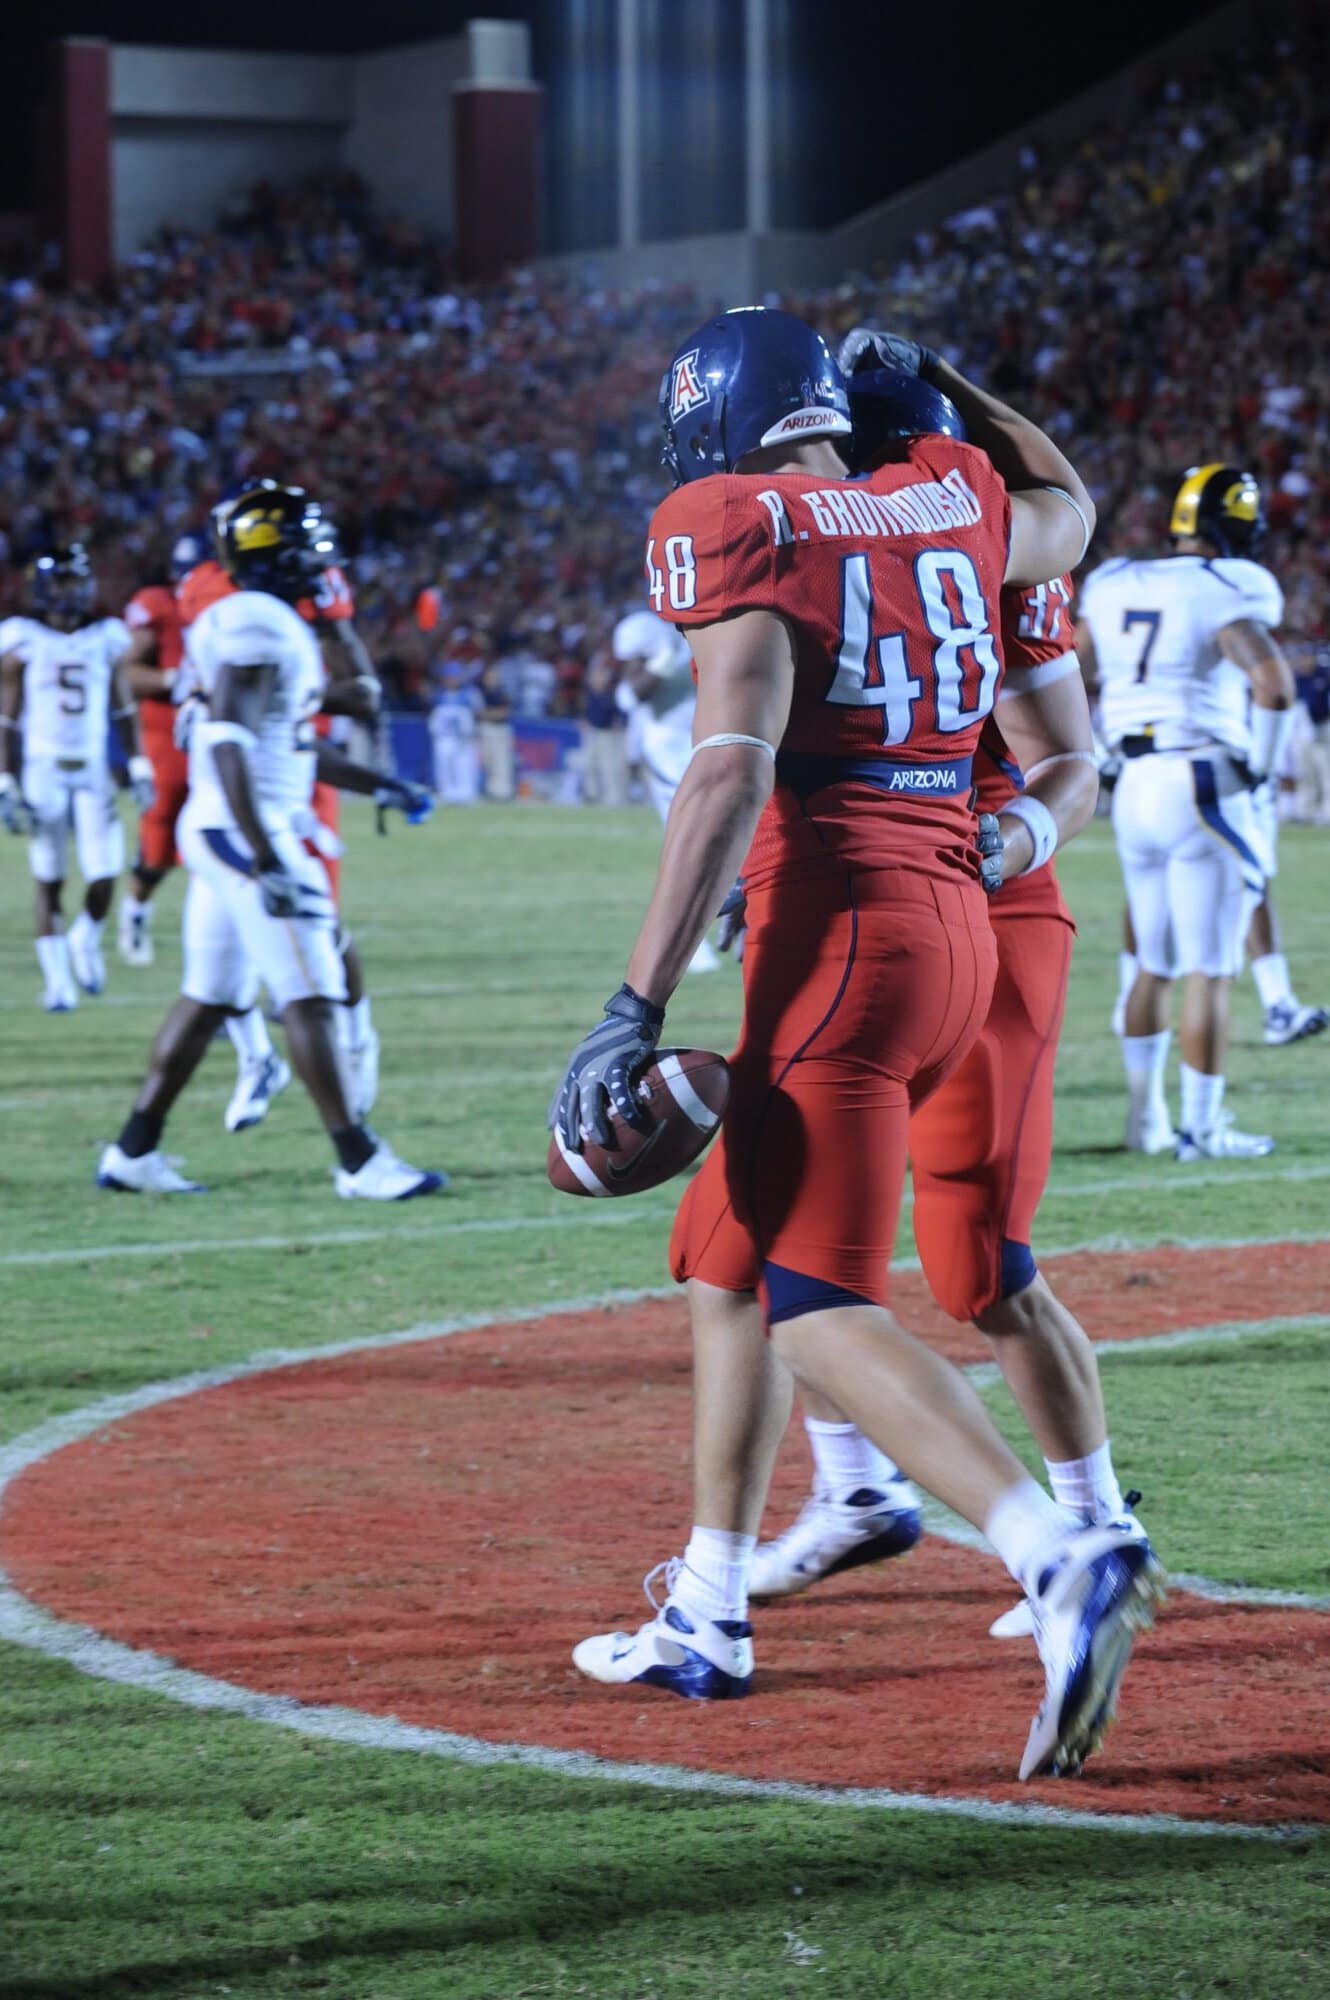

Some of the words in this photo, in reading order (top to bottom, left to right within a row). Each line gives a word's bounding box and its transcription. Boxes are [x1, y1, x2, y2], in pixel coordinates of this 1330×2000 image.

[669, 348, 710, 424] A
[781, 413, 838, 433] ARIZONA
[756, 490, 809, 546] R.
[646, 533, 697, 613] 48
[826, 547, 1000, 746] 48
[1122, 610, 1162, 684] 7
[57, 664, 87, 715] 5
[889, 769, 957, 790] ARIZONA
